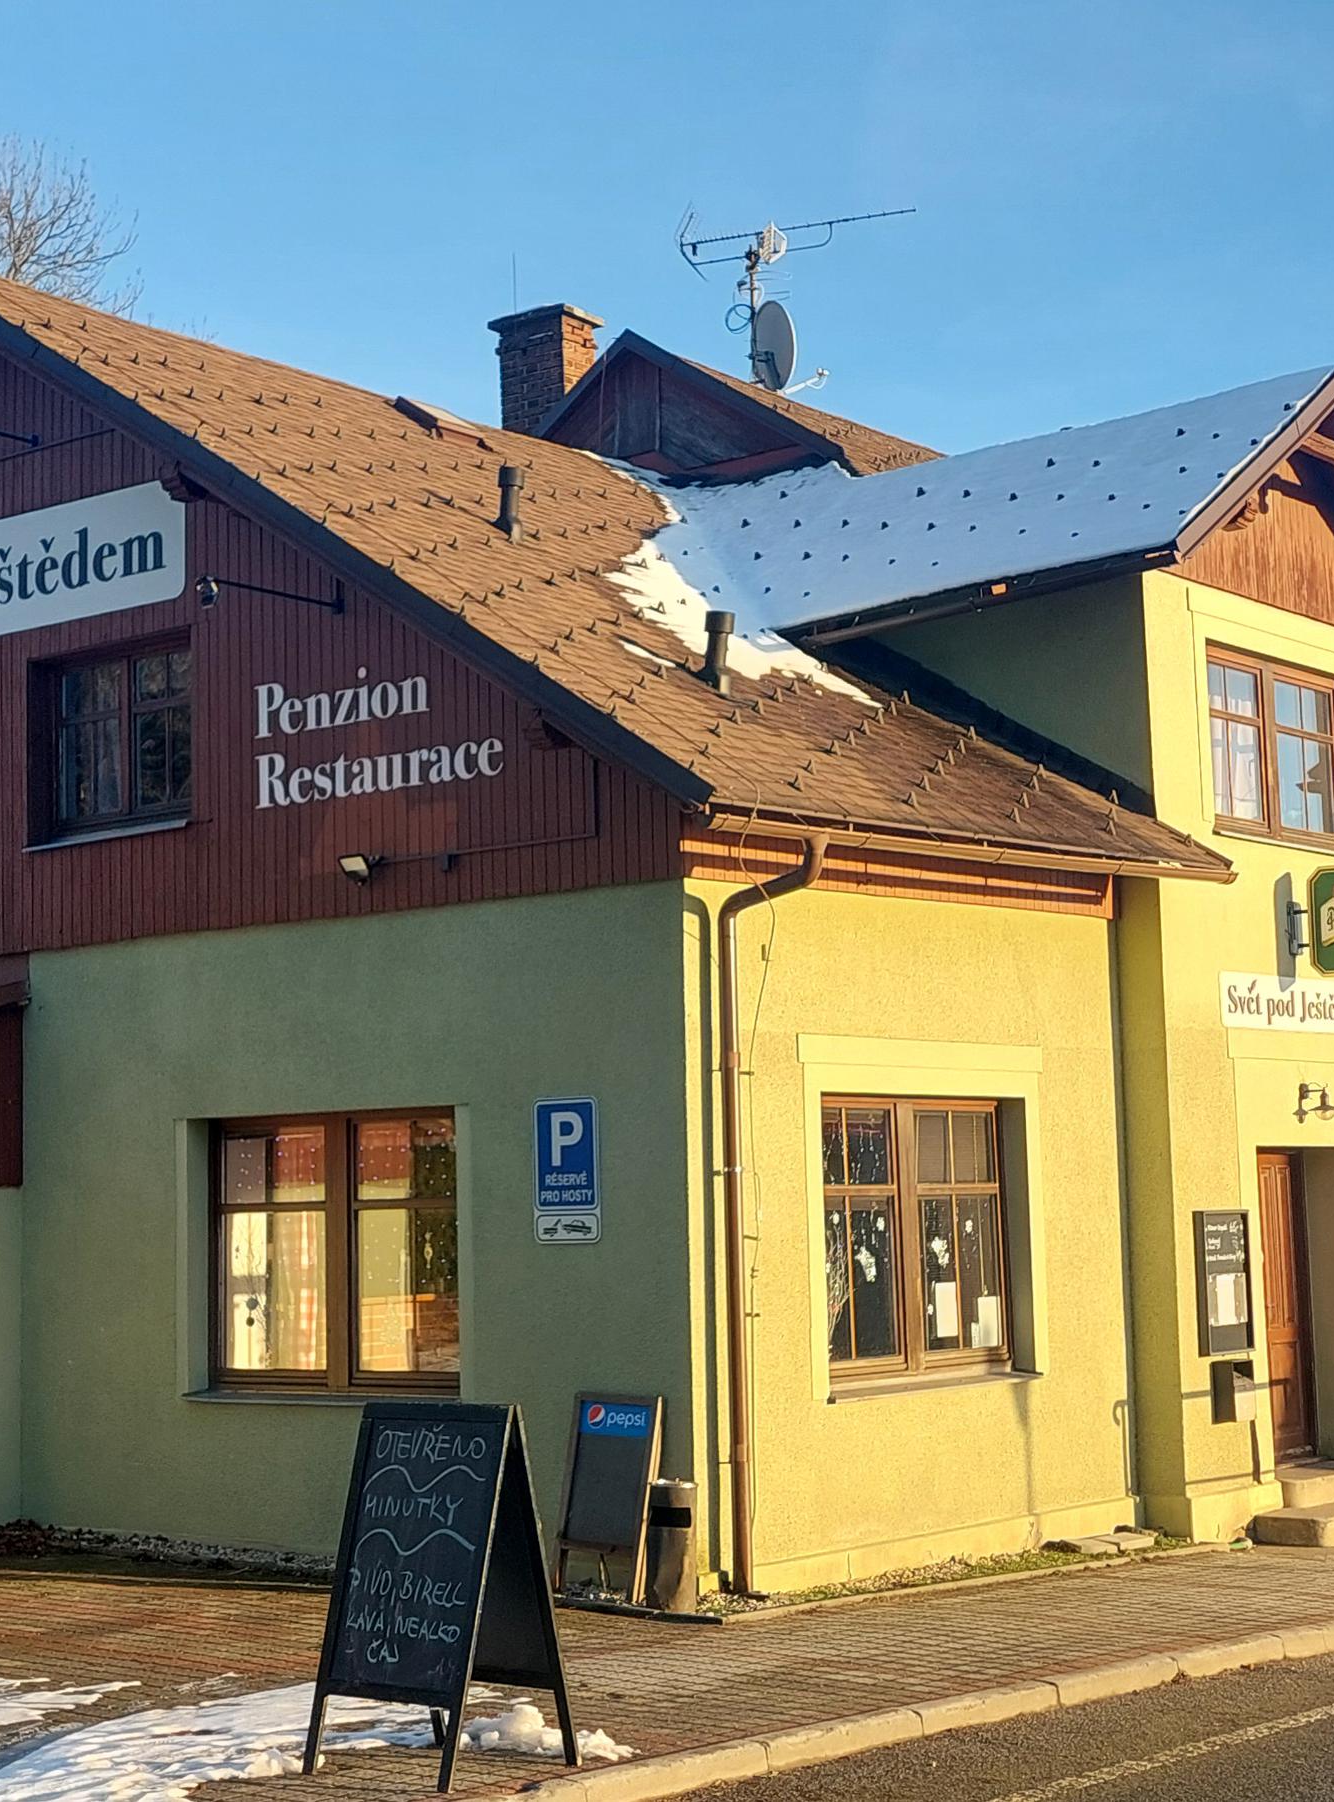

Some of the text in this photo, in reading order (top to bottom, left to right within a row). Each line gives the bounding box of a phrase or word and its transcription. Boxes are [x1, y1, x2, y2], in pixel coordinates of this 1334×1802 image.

[254, 666, 430, 739] Penzion
[255, 737, 504, 809] Restaurace
[1227, 979, 1263, 1015] Svět
[1266, 990, 1295, 1025] pod
[550, 1111, 584, 1167] P
[540, 1189, 593, 1202] PRO HOSTY
[607, 1411, 647, 1429] pepsi
[376, 1424, 487, 1464] OTEVŘENO
[394, 1615, 461, 1643] NEALKO
[366, 1639, 399, 1663] ČAJ
